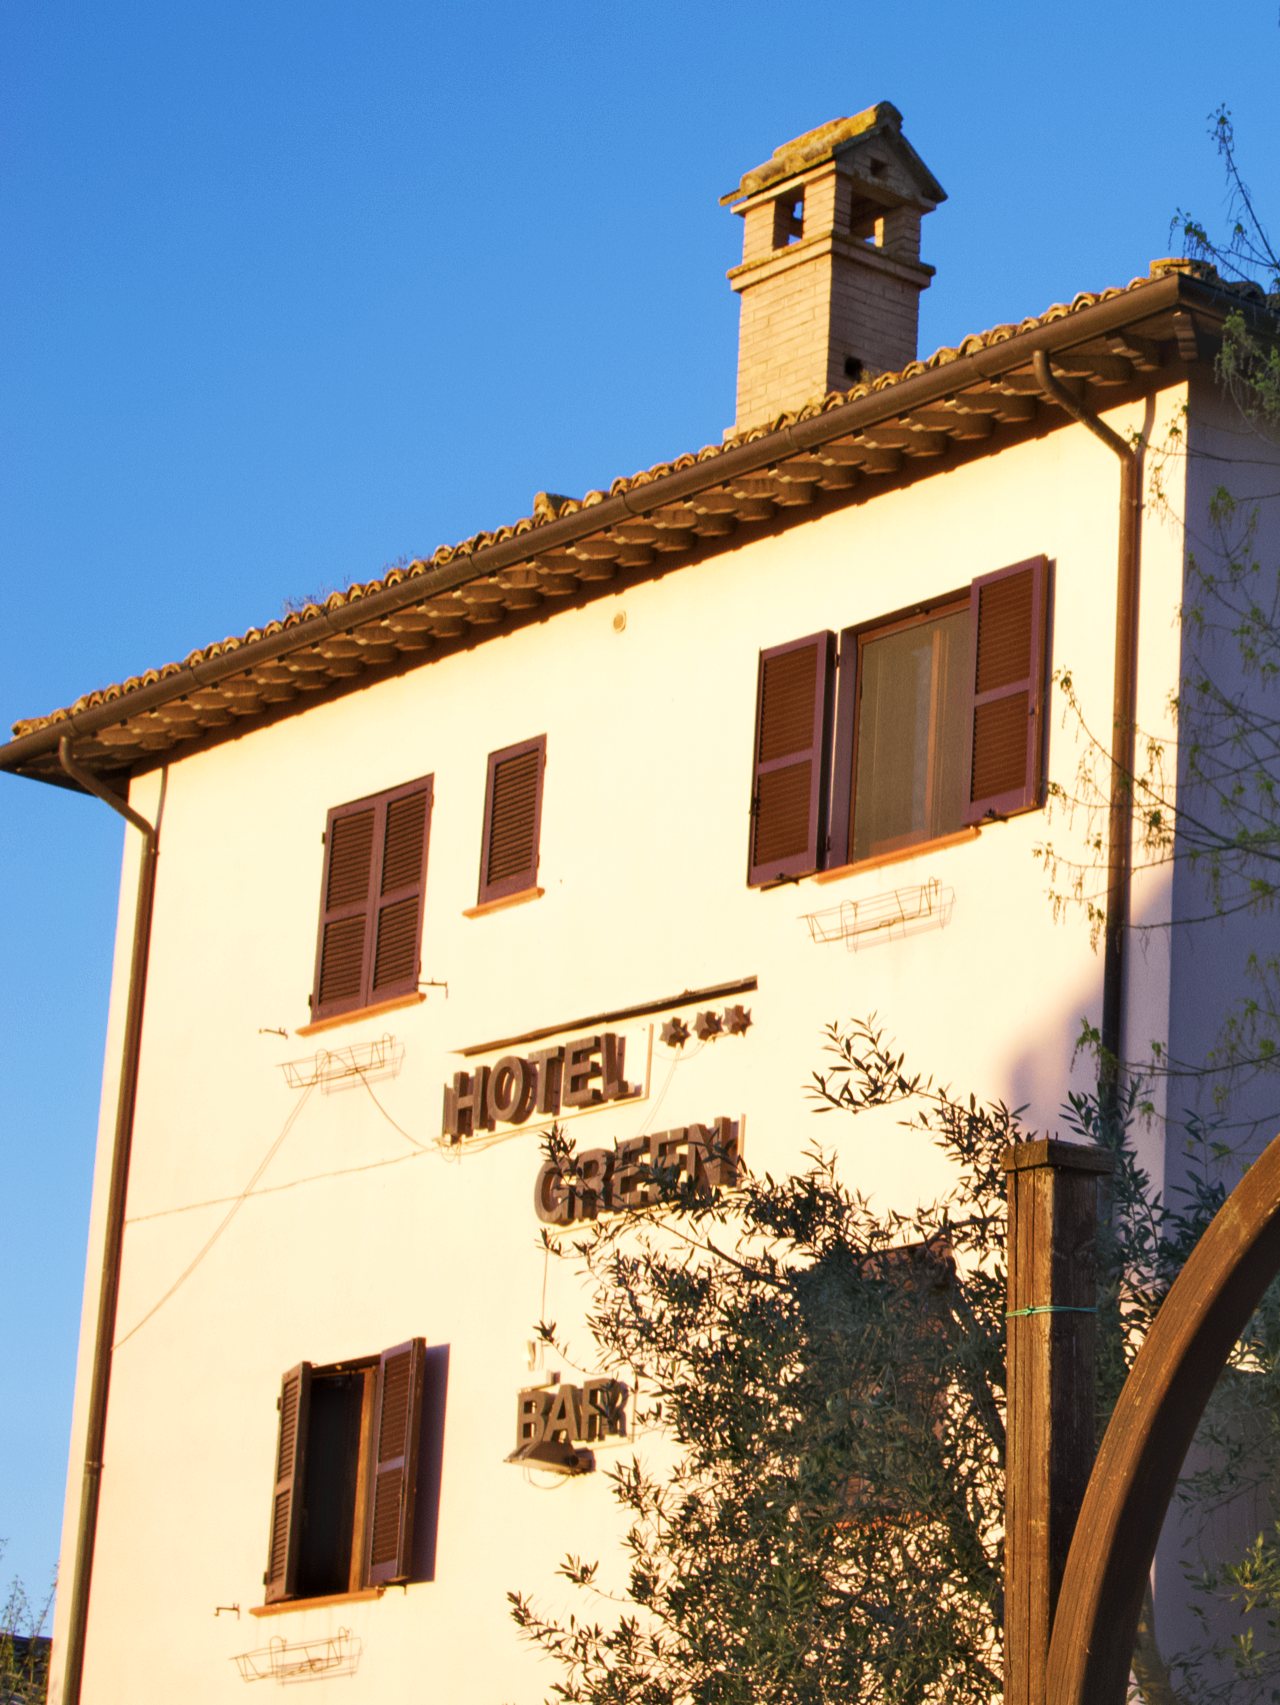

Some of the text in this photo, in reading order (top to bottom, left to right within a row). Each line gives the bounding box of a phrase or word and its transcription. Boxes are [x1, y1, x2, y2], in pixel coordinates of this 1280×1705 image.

[444, 1031, 641, 1144] HOTEL
[534, 1115, 740, 1226] GREEN
[517, 1377, 629, 1451] BAR
